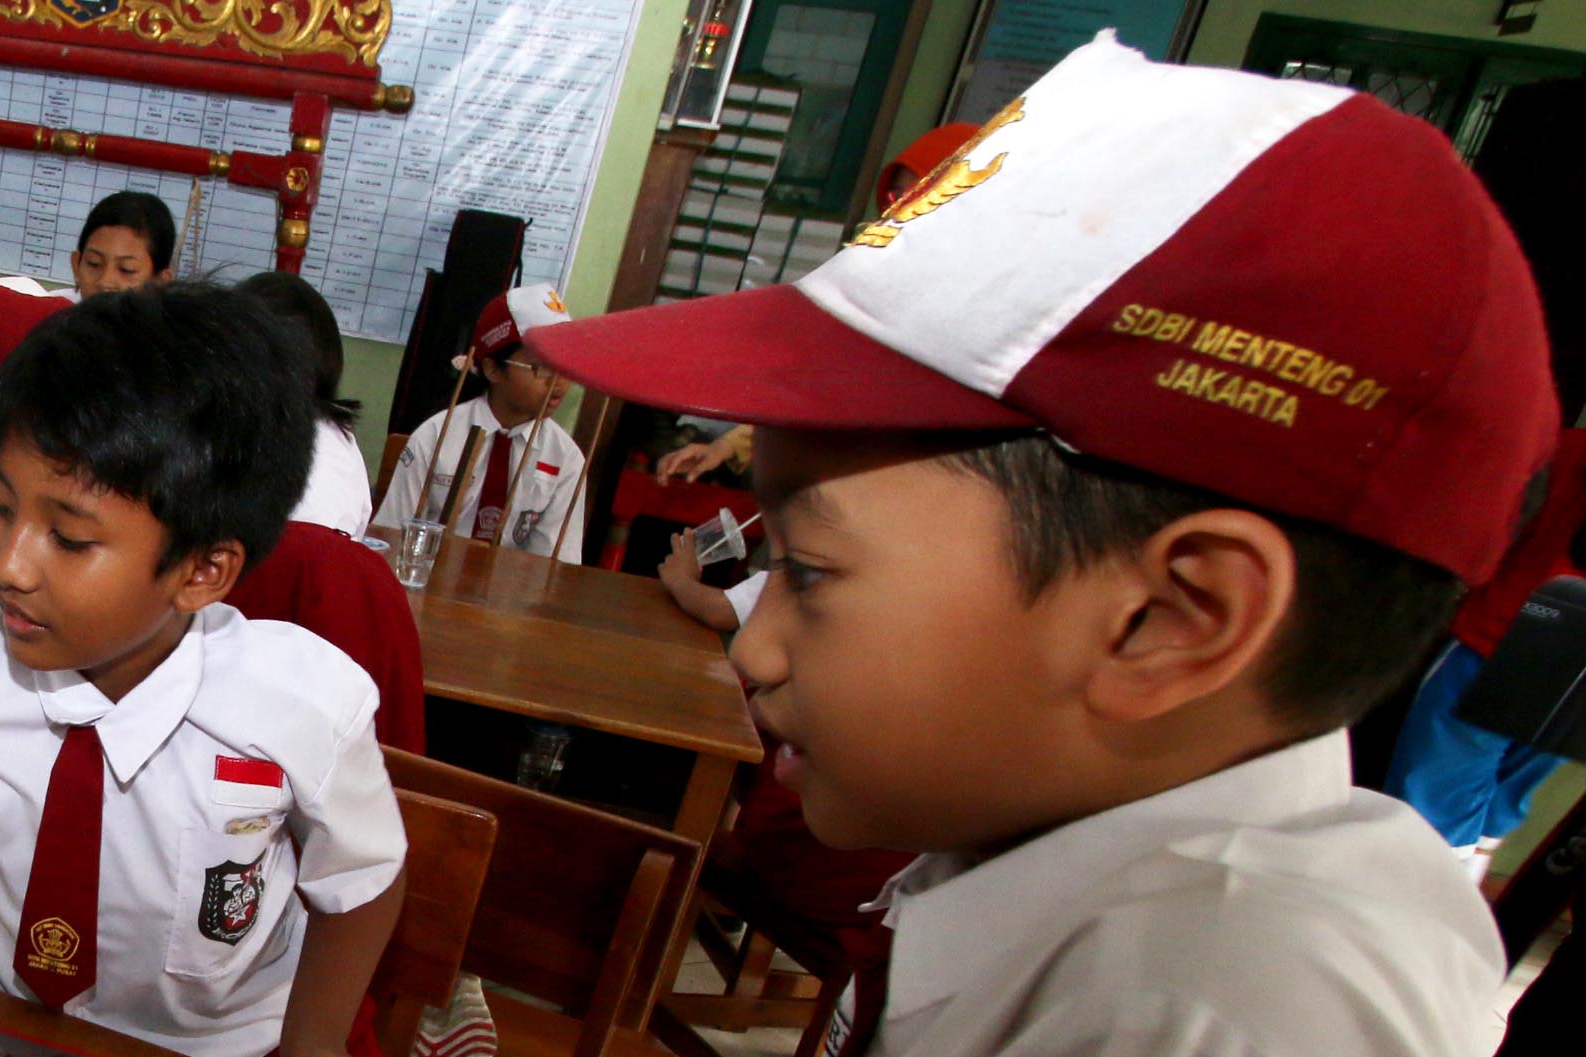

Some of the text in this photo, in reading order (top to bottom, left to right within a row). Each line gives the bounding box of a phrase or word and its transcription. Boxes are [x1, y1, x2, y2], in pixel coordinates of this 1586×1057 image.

[1113, 303, 1391, 411] SDBI MENTENG 01
[1156, 358, 1300, 428] JAKARTA
